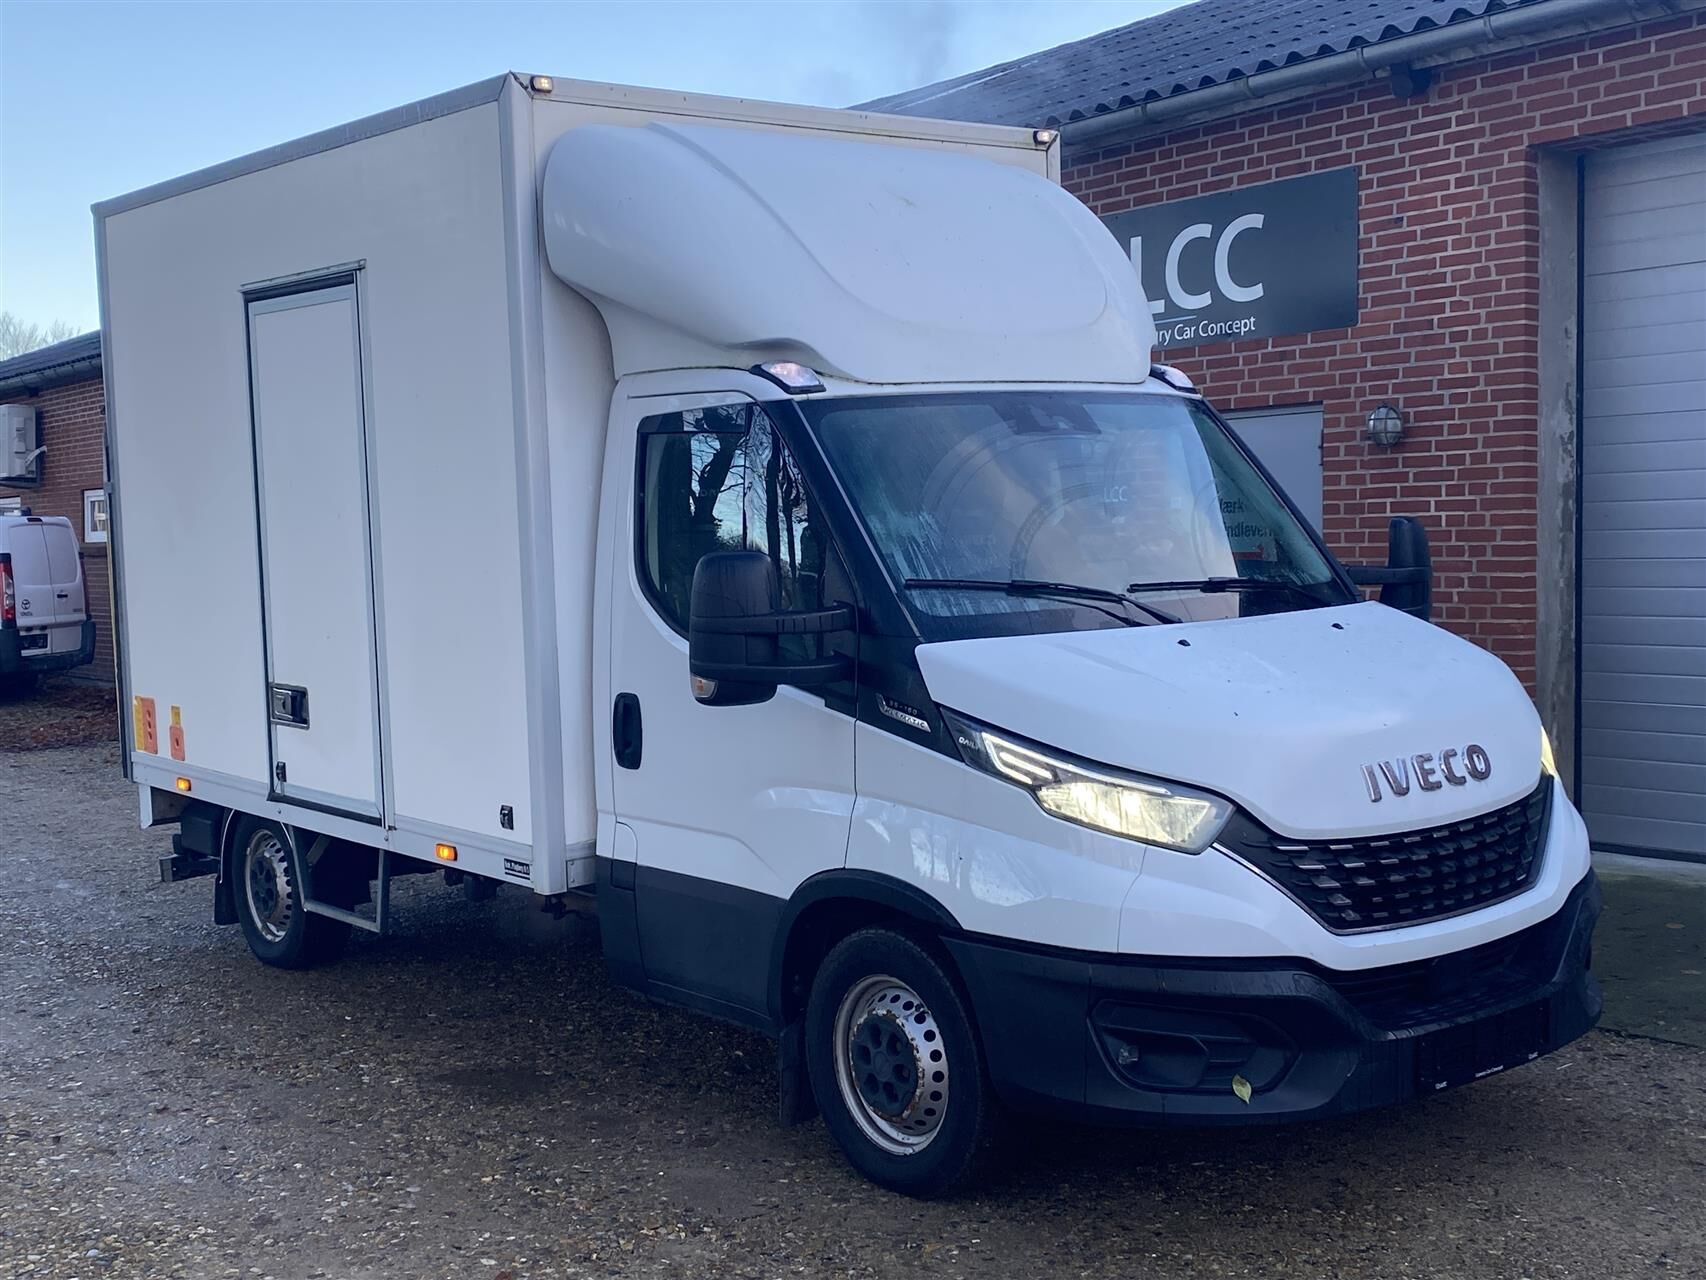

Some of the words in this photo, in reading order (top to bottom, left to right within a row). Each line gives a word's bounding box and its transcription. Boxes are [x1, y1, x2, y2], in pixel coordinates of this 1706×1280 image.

[1130, 213, 1265, 314] LCC
[1174, 323, 1197, 340] Car
[1199, 316, 1256, 336] Concept
[1361, 744, 1492, 803] IVECO
